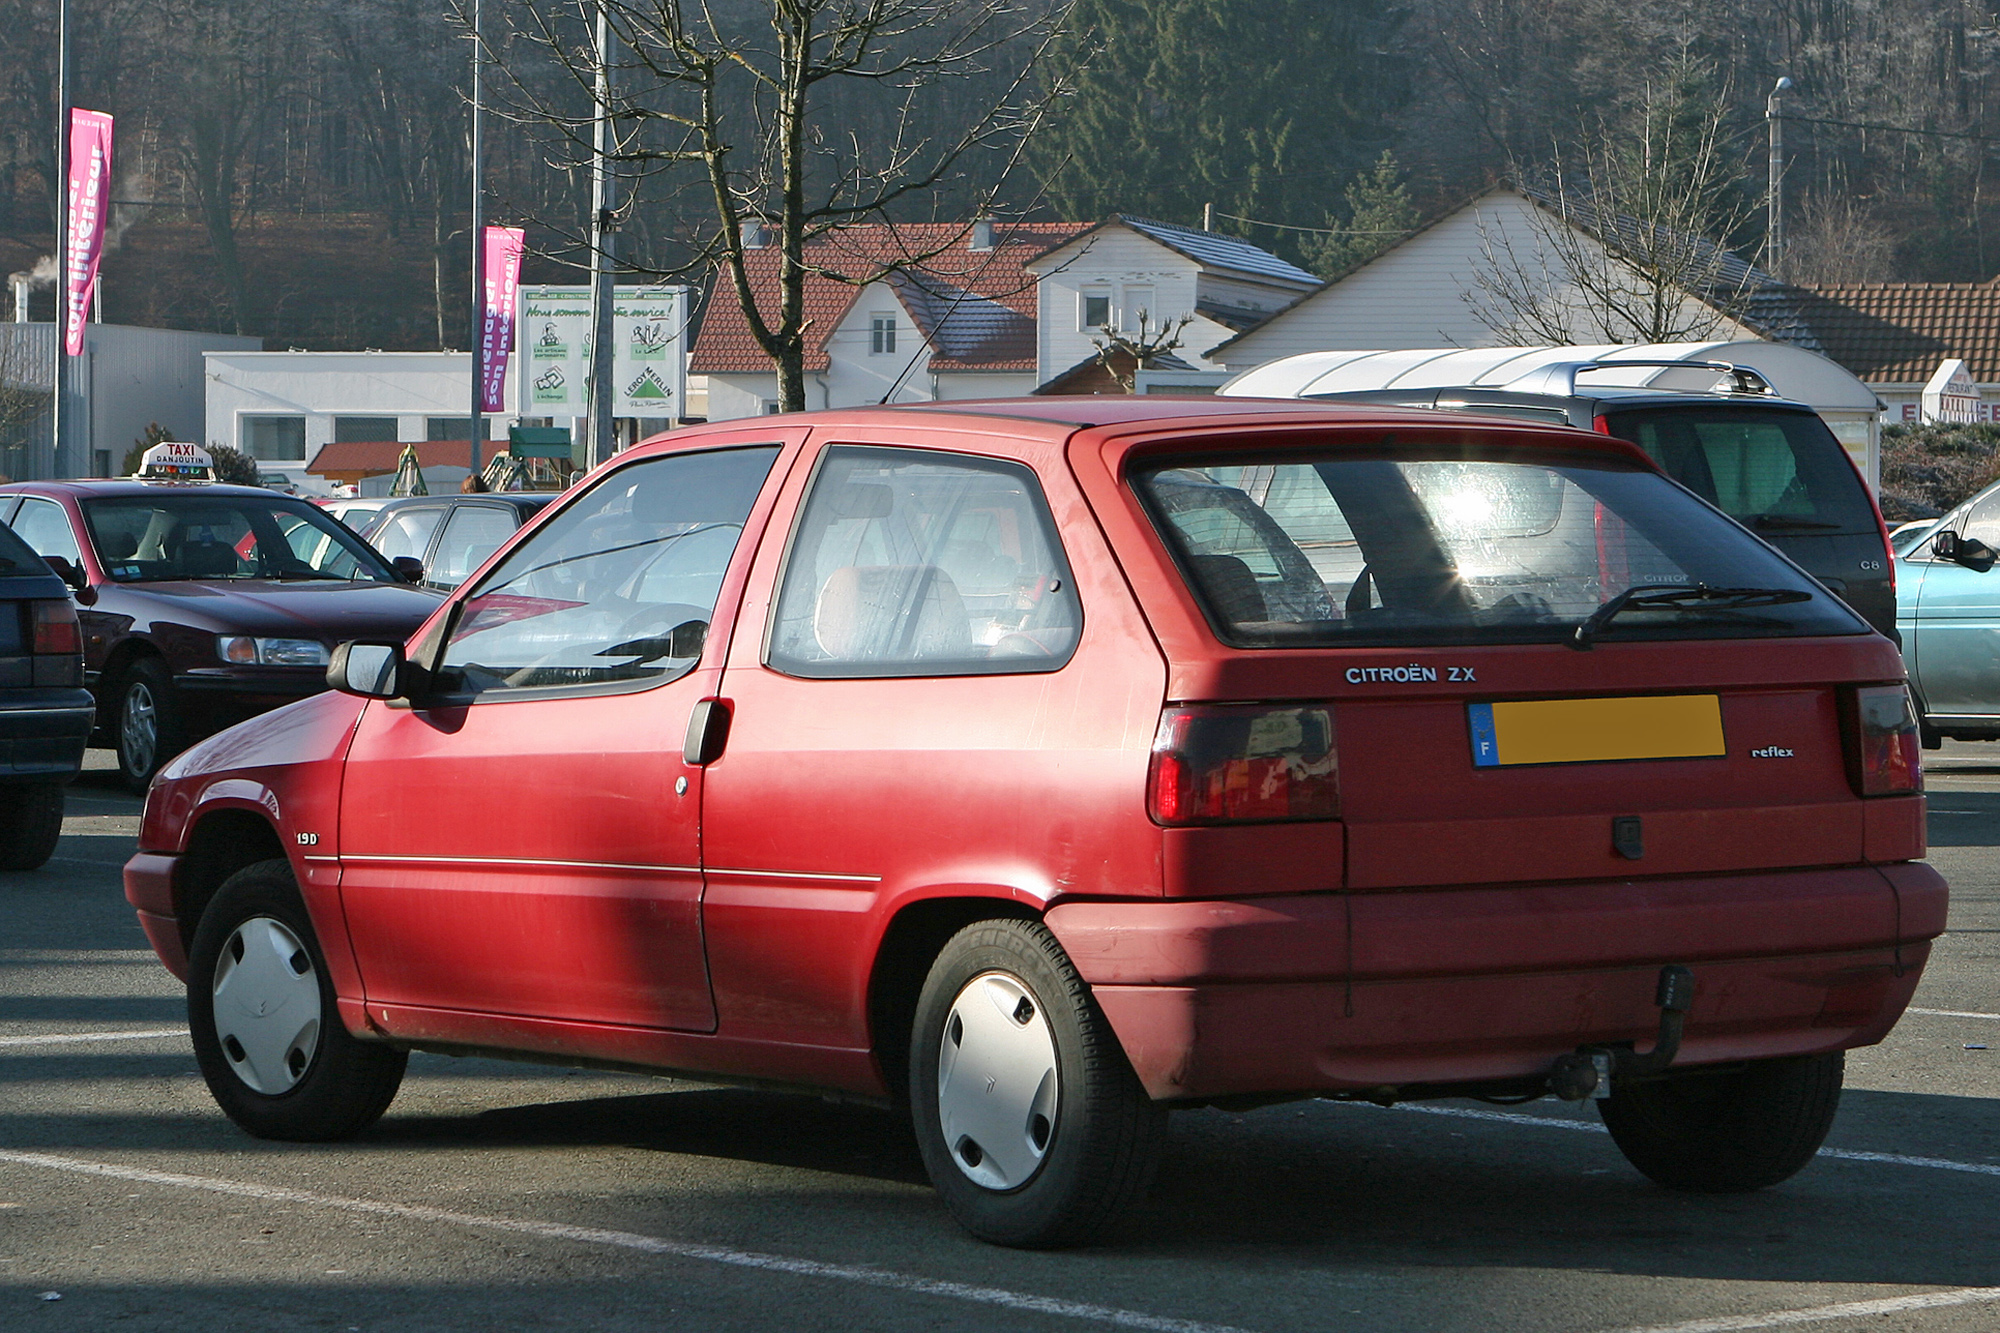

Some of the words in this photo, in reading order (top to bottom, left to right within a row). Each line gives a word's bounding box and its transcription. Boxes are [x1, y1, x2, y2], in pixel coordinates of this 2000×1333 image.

[552, 308, 591, 318] somme
[488, 365, 505, 405] son
[623, 372, 647, 397] LEROY
[644, 366, 674, 397] MERLIN
[167, 443, 195, 456] TAXI
[156, 455, 204, 464] DANJOUTIN
[1860, 560, 1880, 570] C8
[1346, 663, 1438, 685] CITROËN
[1446, 667, 1477, 682] ZX
[1480, 741, 1490, 757] F
[1751, 745, 1795, 758] reflex
